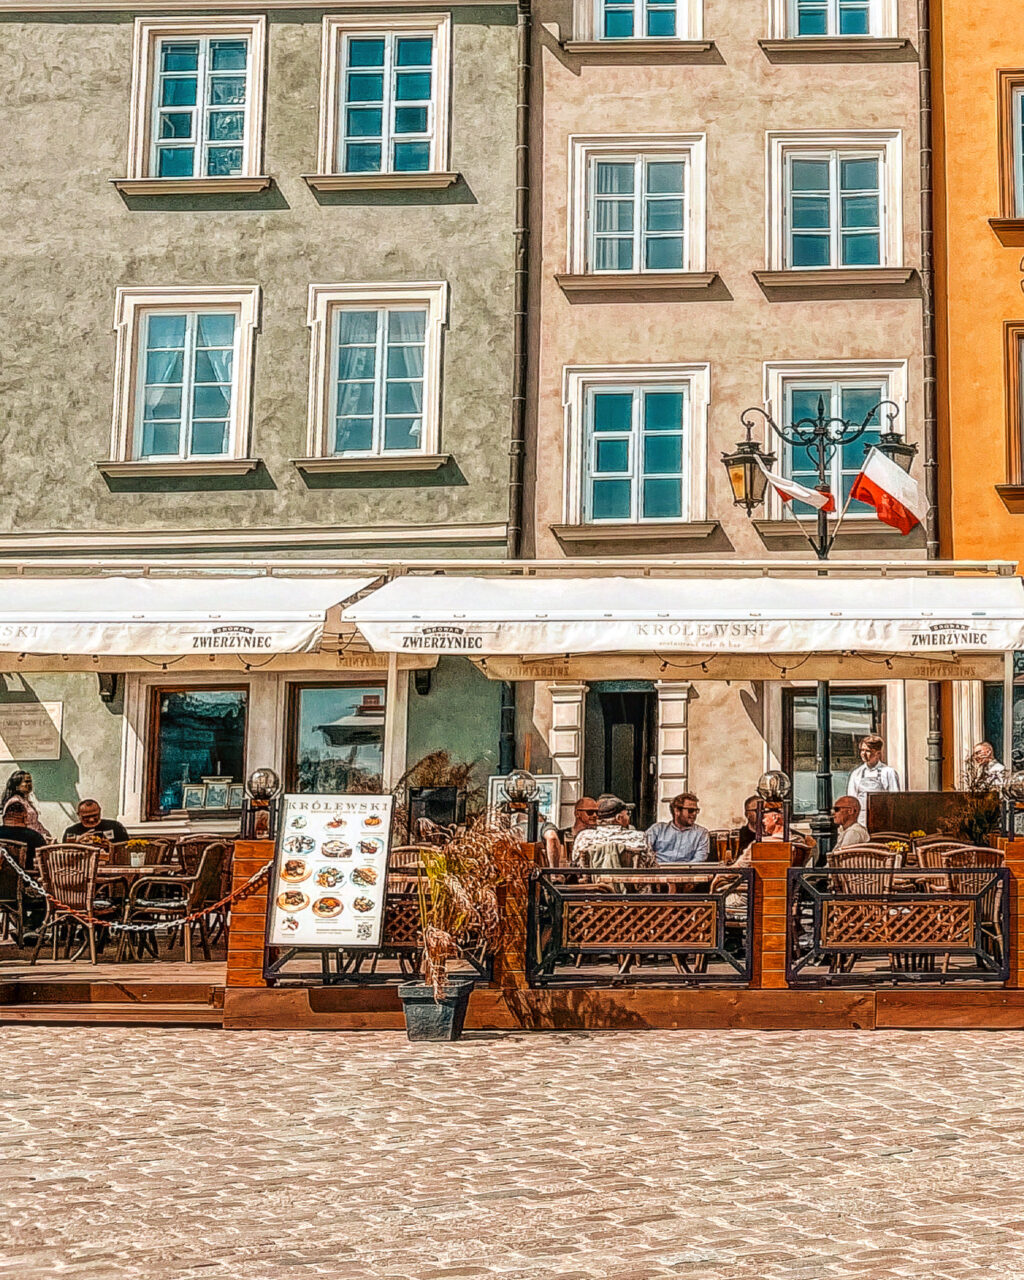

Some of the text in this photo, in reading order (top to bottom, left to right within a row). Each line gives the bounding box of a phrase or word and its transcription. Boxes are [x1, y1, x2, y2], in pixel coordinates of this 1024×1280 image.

[0, 625, 38, 638] SKI
[192, 636, 272, 649] ZWIERZYNIEC
[402, 636, 483, 649] ZWIERZYNIEC
[911, 632, 988, 646] ZWIERZYNIEC
[288, 800, 388, 811] KRÓLEWSKI
